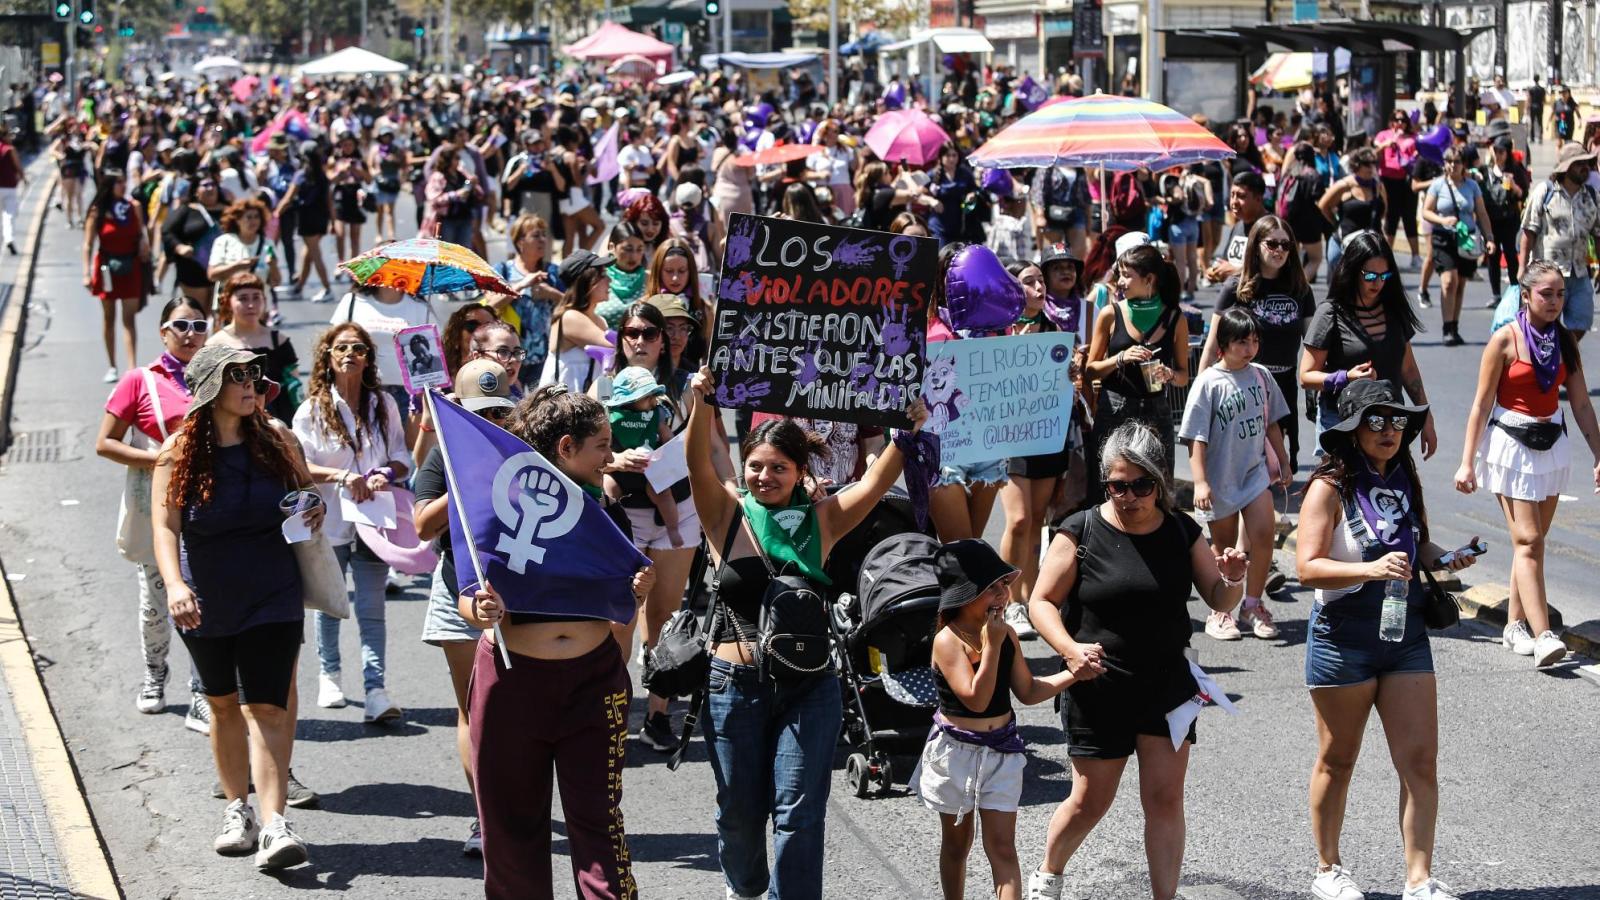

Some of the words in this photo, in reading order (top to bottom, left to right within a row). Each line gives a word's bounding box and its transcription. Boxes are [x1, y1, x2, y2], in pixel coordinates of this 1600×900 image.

[756, 224, 833, 271] LOS
[712, 344, 806, 376] ANTES
[814, 349, 867, 378] QUE
[874, 353, 917, 380] LAS
[969, 350, 992, 377] EL
[1043, 368, 1062, 392] SE
[1000, 401, 1015, 419] EN
[1216, 390, 1247, 431] NEW
